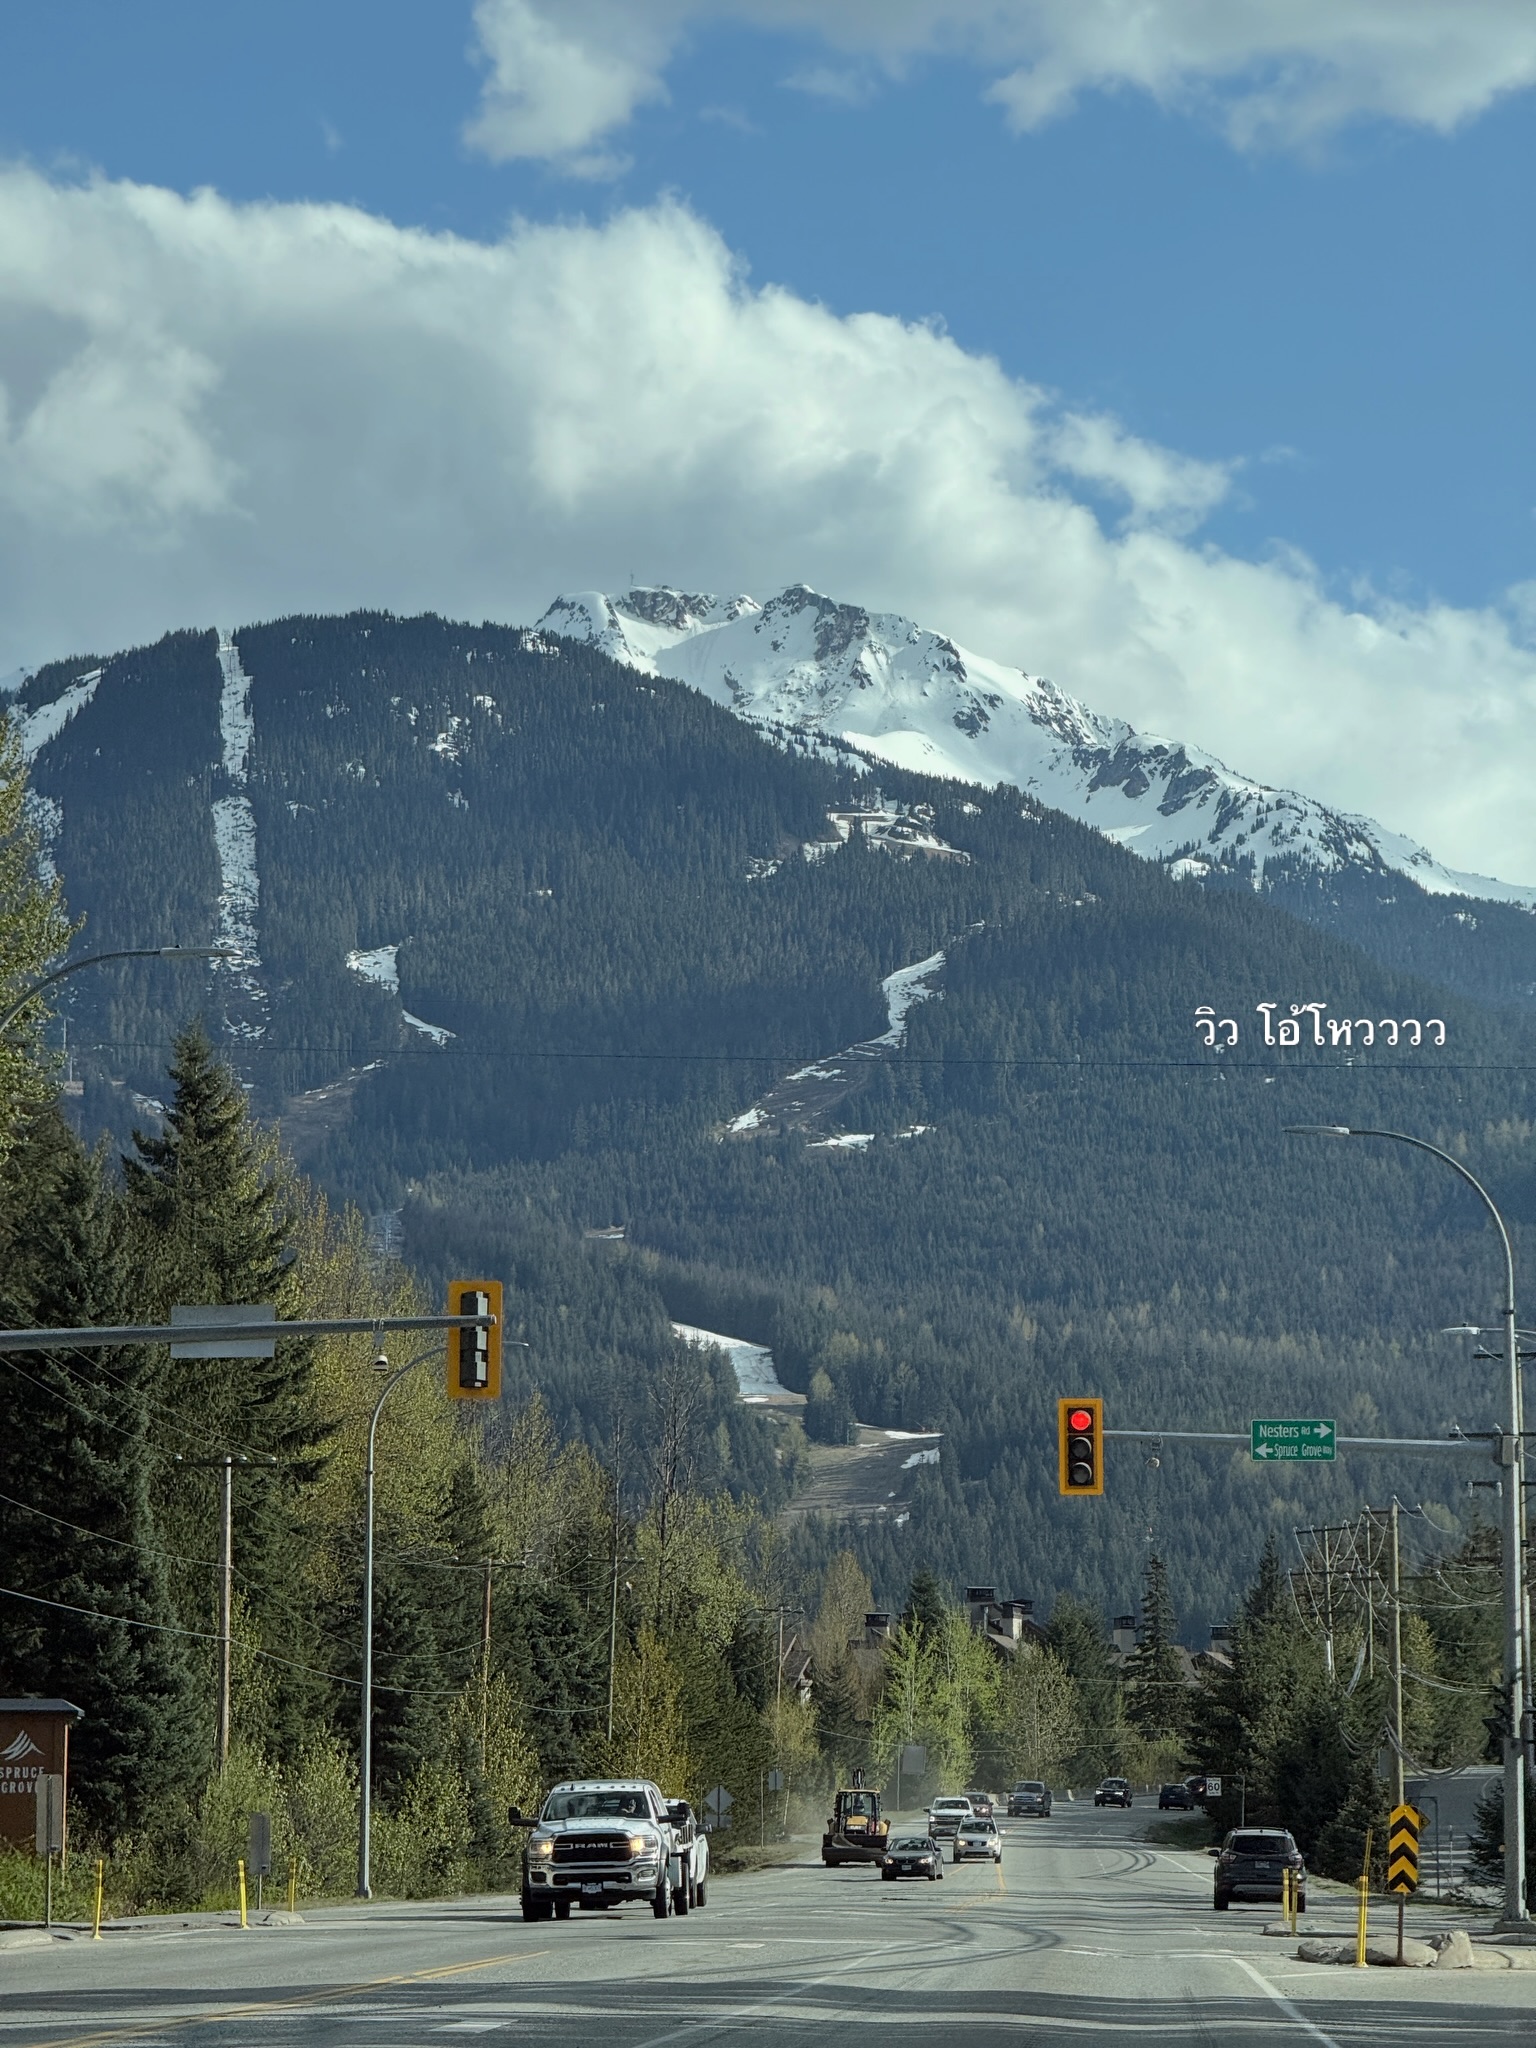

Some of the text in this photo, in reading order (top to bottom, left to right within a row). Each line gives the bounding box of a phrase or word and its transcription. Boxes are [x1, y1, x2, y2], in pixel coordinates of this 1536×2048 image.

[1259, 1424, 1311, 1438] Nesters Rd
[1274, 1443, 1298, 1459] Spruce
[1301, 1443, 1322, 1456] Grove
[1, 1781, 37, 1794] GROV
[1207, 1782, 1220, 1791] 60
